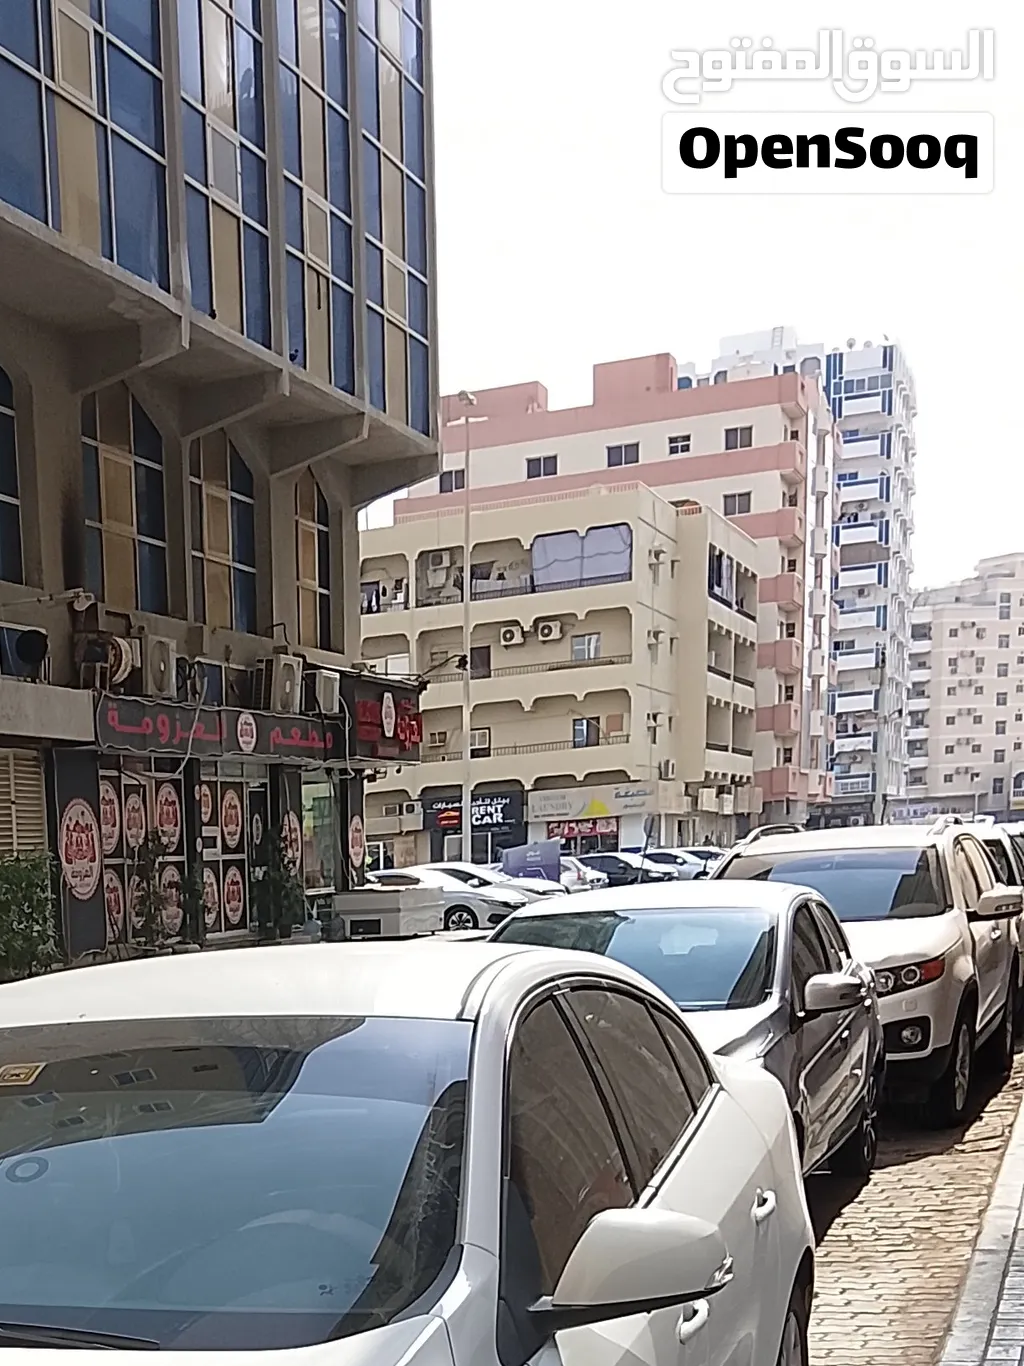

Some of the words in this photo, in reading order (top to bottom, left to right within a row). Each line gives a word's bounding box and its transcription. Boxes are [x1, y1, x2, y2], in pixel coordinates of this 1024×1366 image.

[270, 726, 334, 752] مطعم
[471, 804, 504, 815] RENT
[471, 813, 504, 825] CAR
